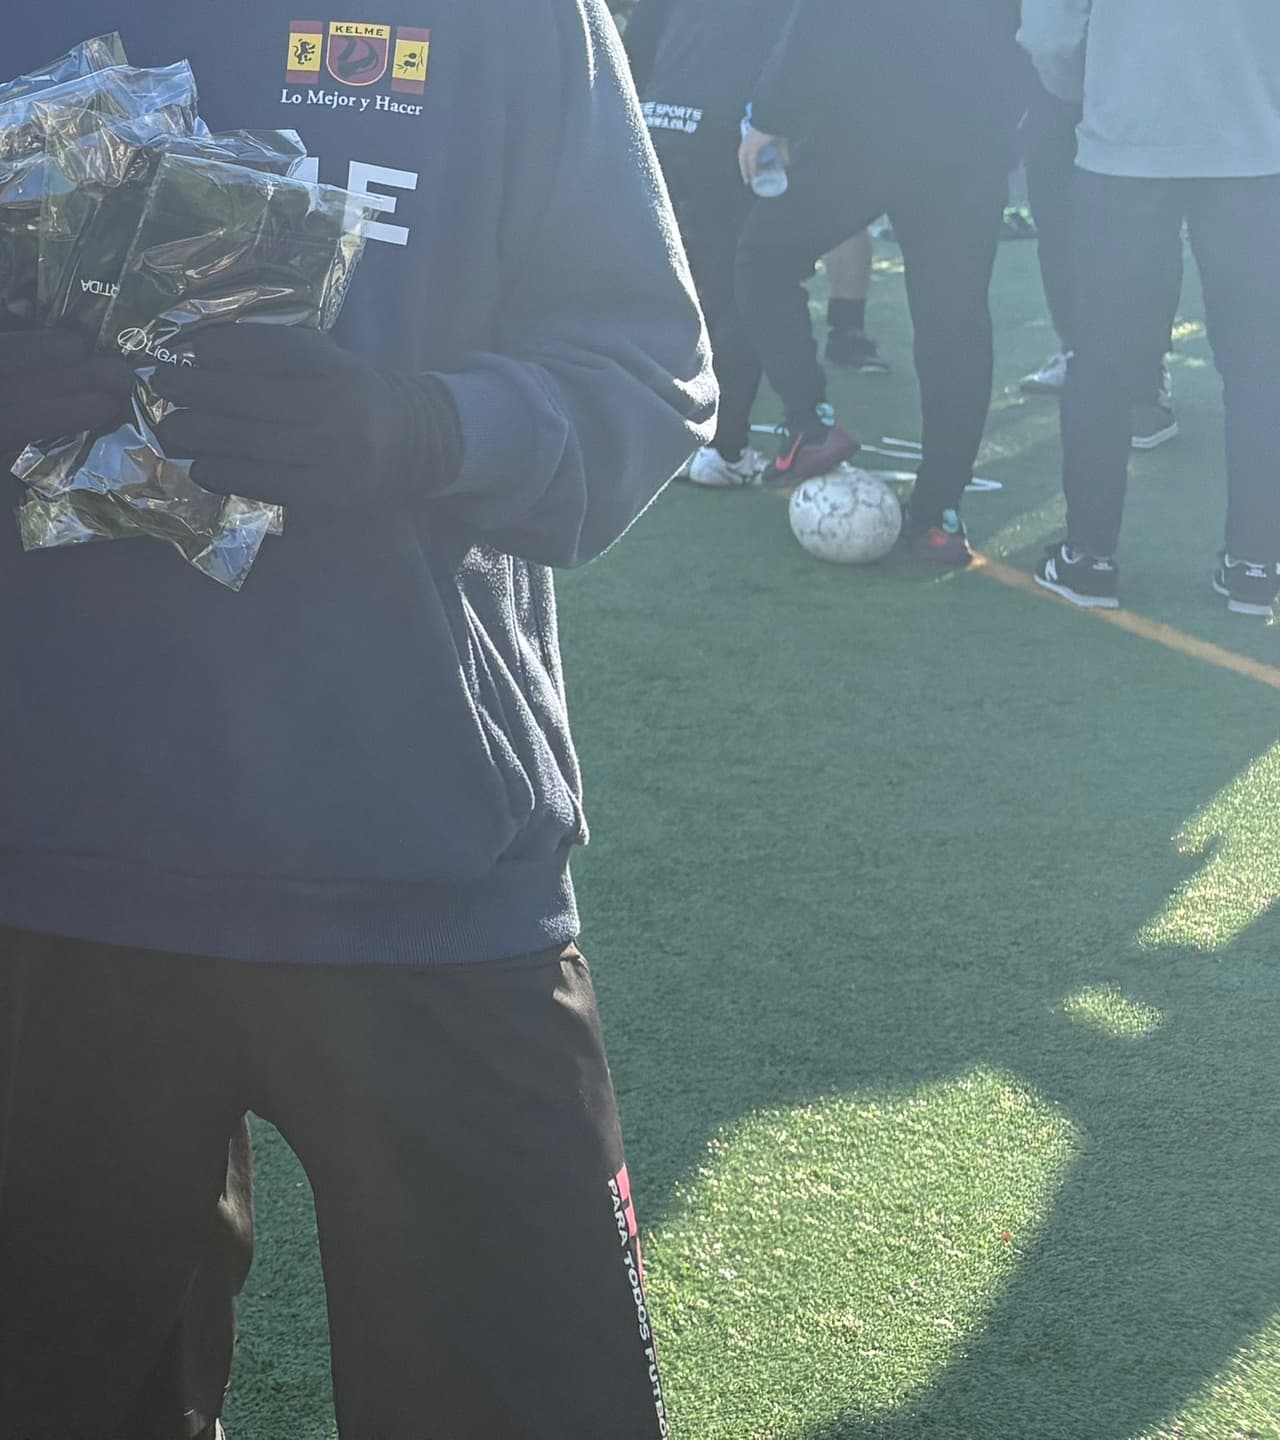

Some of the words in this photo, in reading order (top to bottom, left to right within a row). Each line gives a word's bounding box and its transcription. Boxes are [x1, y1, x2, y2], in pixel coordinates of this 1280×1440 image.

[335, 25, 385, 37] KELME
[280, 89, 302, 104] Lo
[307, 90, 356, 109] Mejor
[359, 97, 371, 111] y
[375, 95, 423, 116] Hacer
[607, 1178, 628, 1247] PARA
[623, 1250, 650, 1341] TODOS
